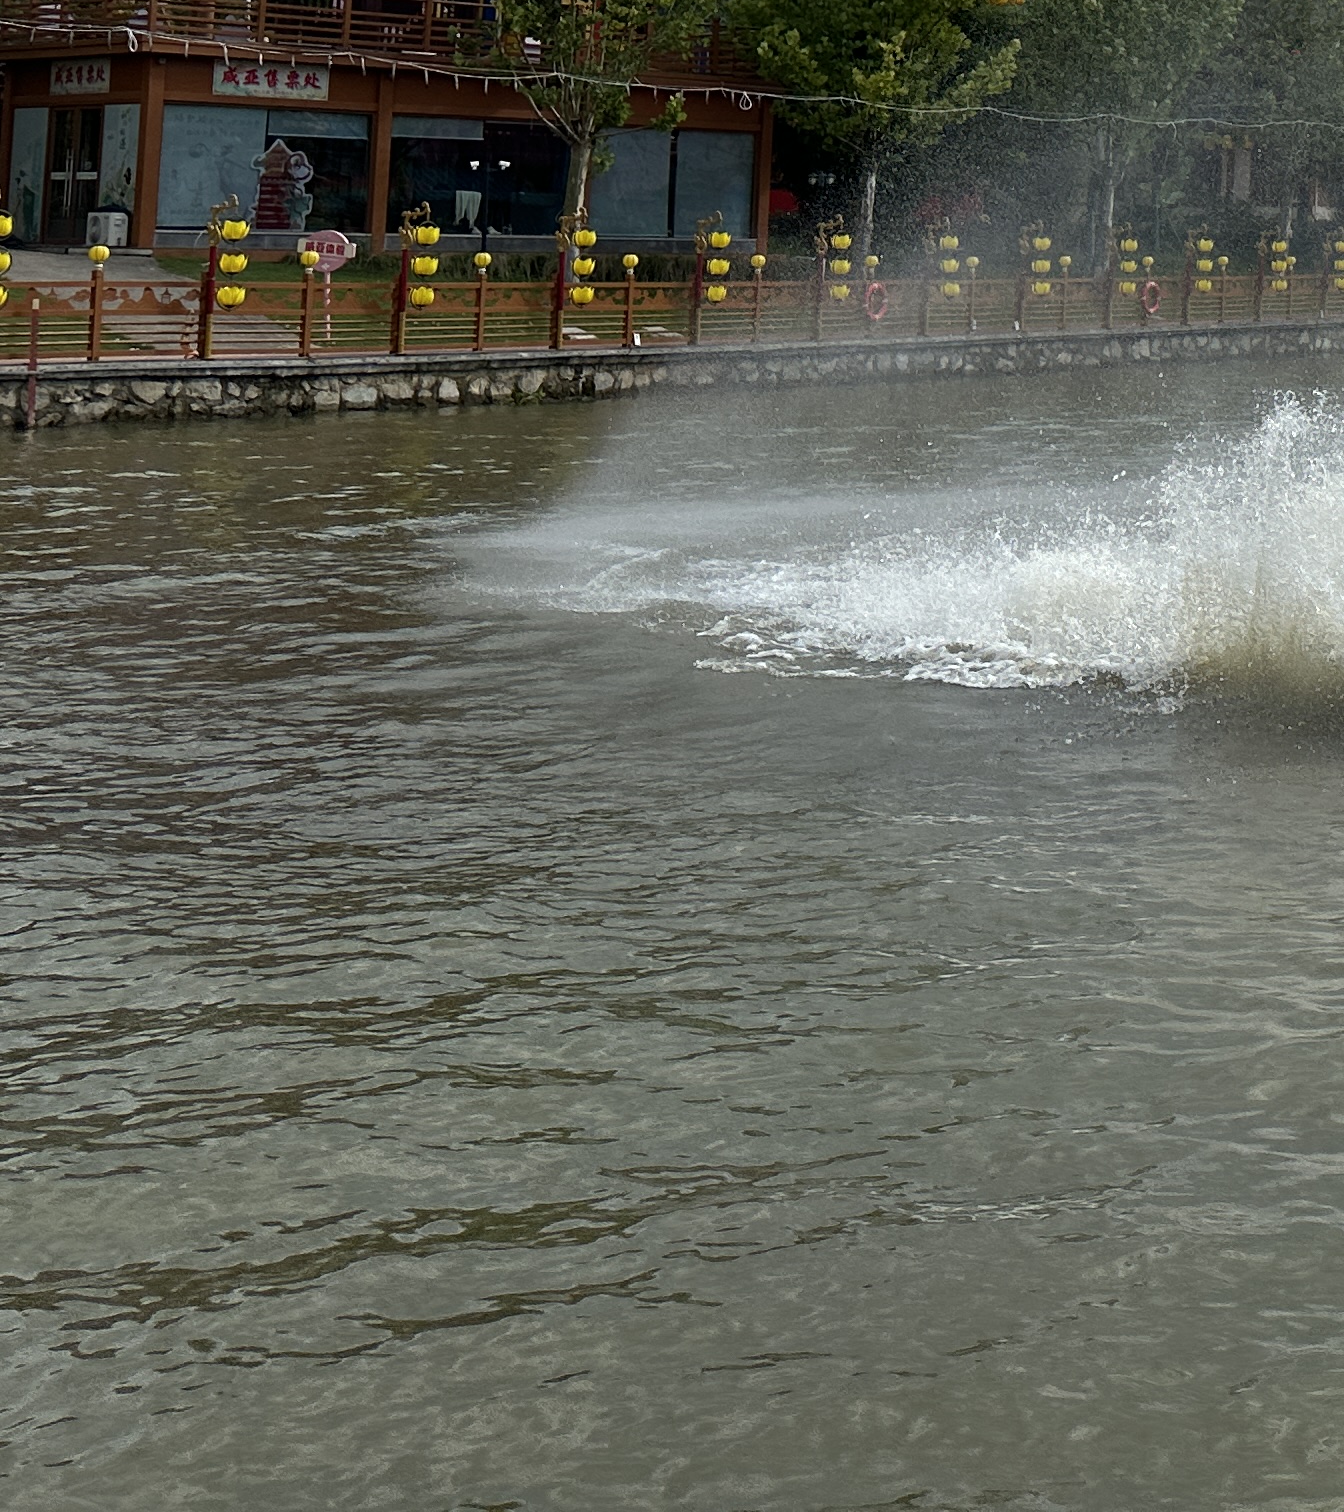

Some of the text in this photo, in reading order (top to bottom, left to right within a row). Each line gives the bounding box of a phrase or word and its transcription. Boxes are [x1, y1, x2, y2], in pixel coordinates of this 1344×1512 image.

[221, 66, 322, 90] 威亚售票处
